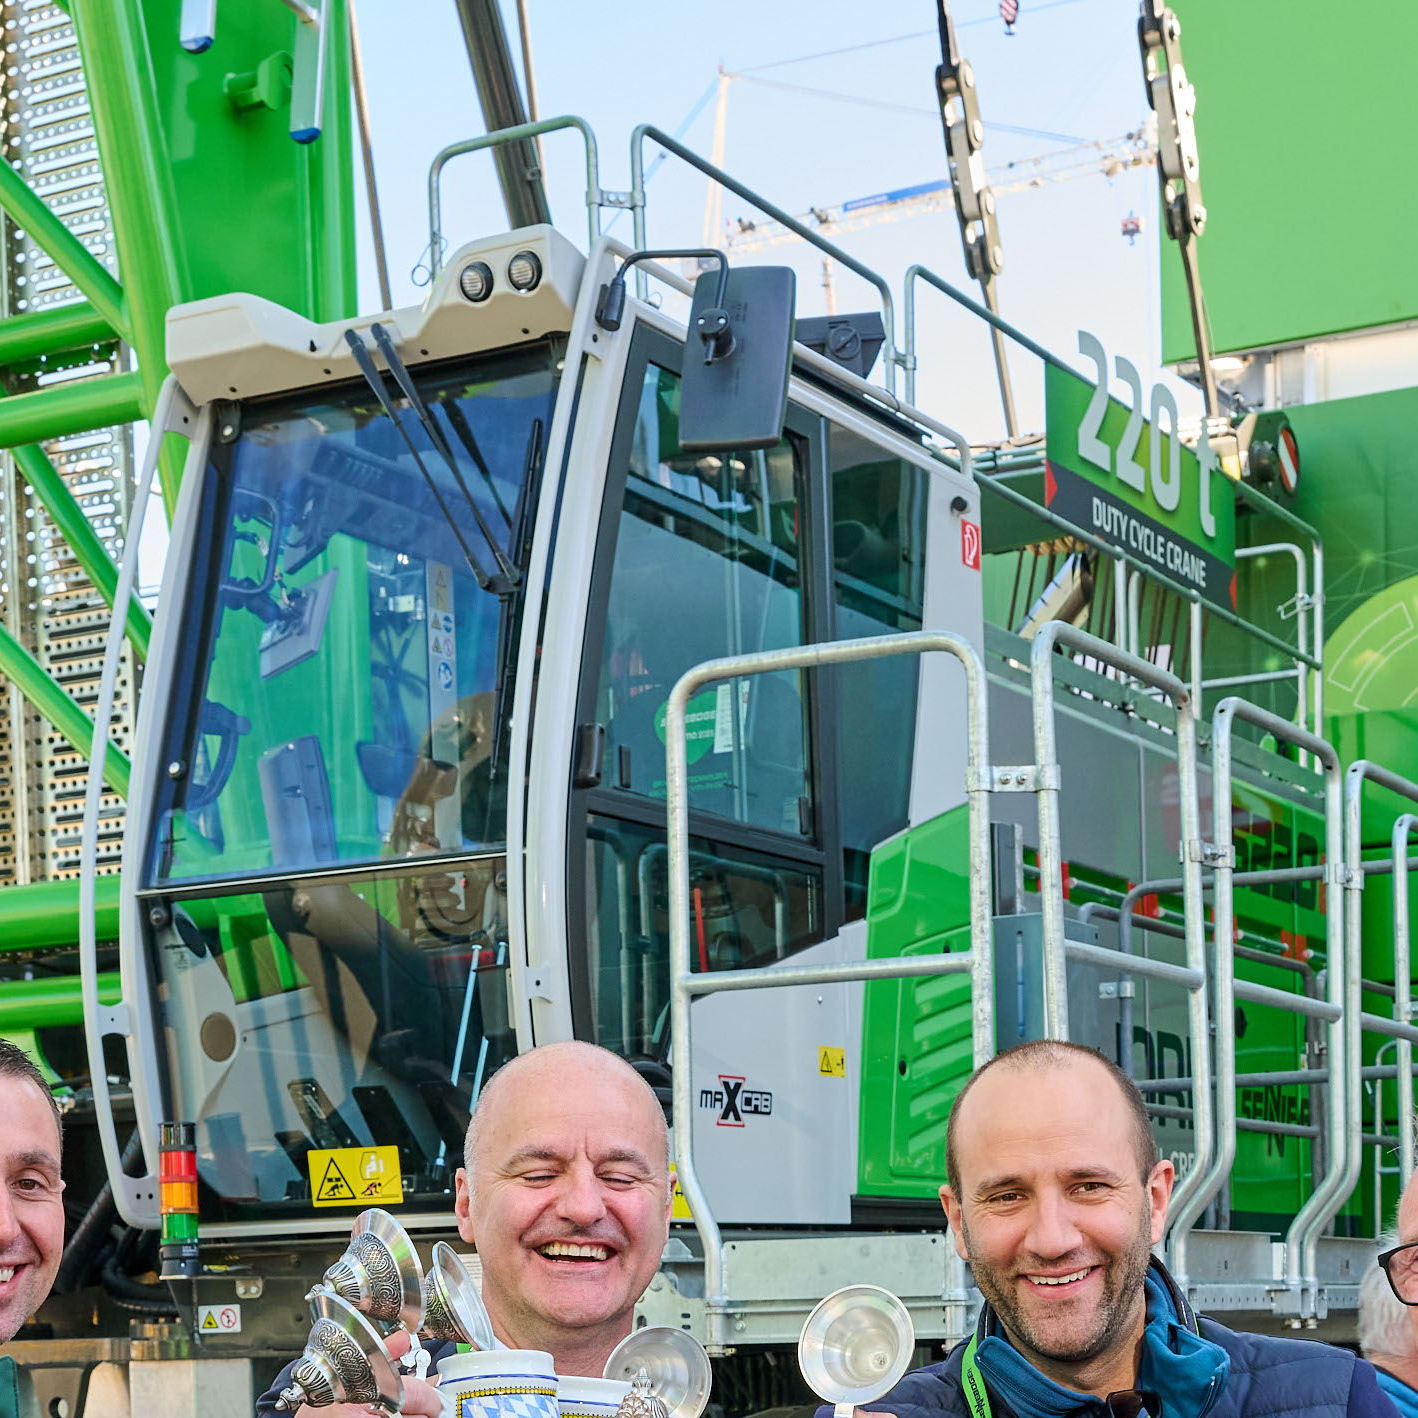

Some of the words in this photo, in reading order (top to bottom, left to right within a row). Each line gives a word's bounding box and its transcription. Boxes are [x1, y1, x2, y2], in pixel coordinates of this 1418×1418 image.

[1078, 329, 1181, 512] 220
[1092, 496, 1129, 541] DUTY
[1130, 519, 1166, 565] CYCLE
[1167, 541, 1207, 588] CRANE
[699, 1078, 773, 1124] MAXCAB
